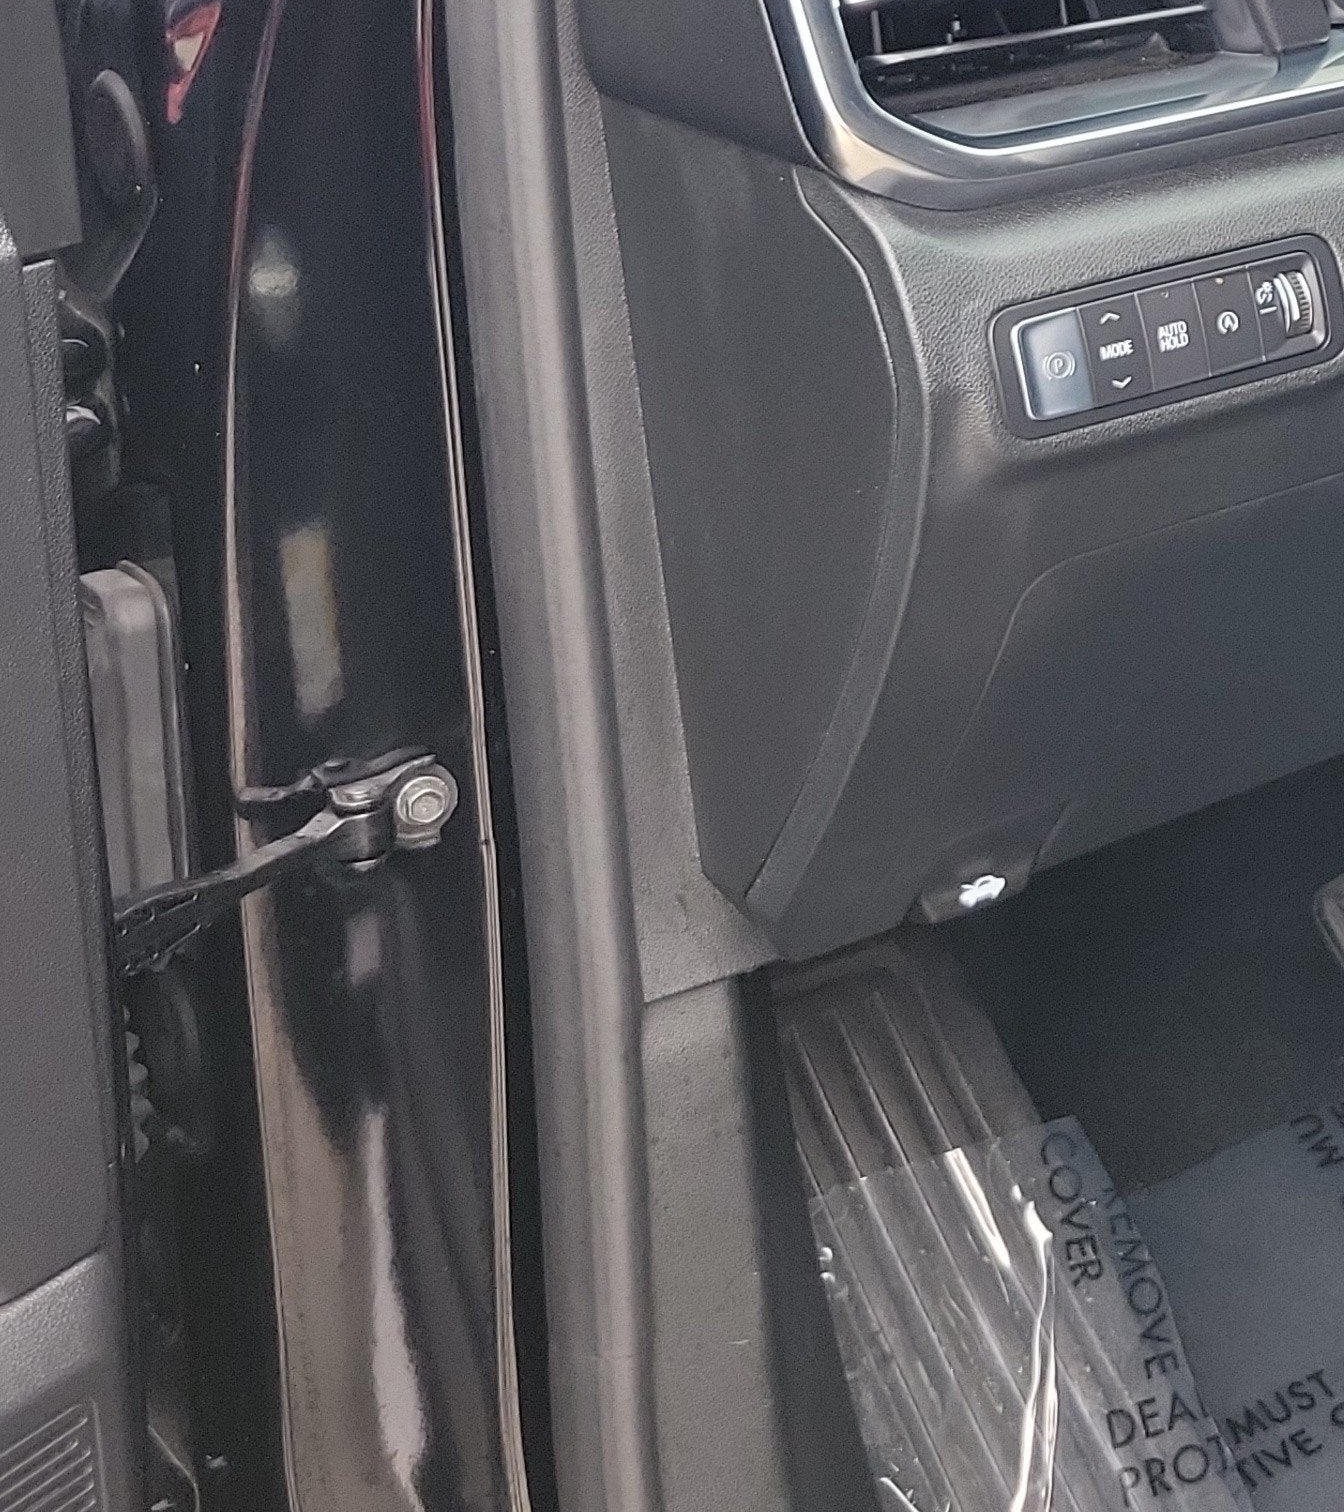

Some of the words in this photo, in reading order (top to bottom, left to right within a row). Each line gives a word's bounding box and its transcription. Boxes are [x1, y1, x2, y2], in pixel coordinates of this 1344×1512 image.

[1158, 321, 1188, 339] AUTO
[1100, 339, 1134, 361] MODE
[1160, 334, 1189, 353] HOLD
[1040, 1132, 1104, 1287] COVER
[1226, 1369, 1335, 1444] MUST
